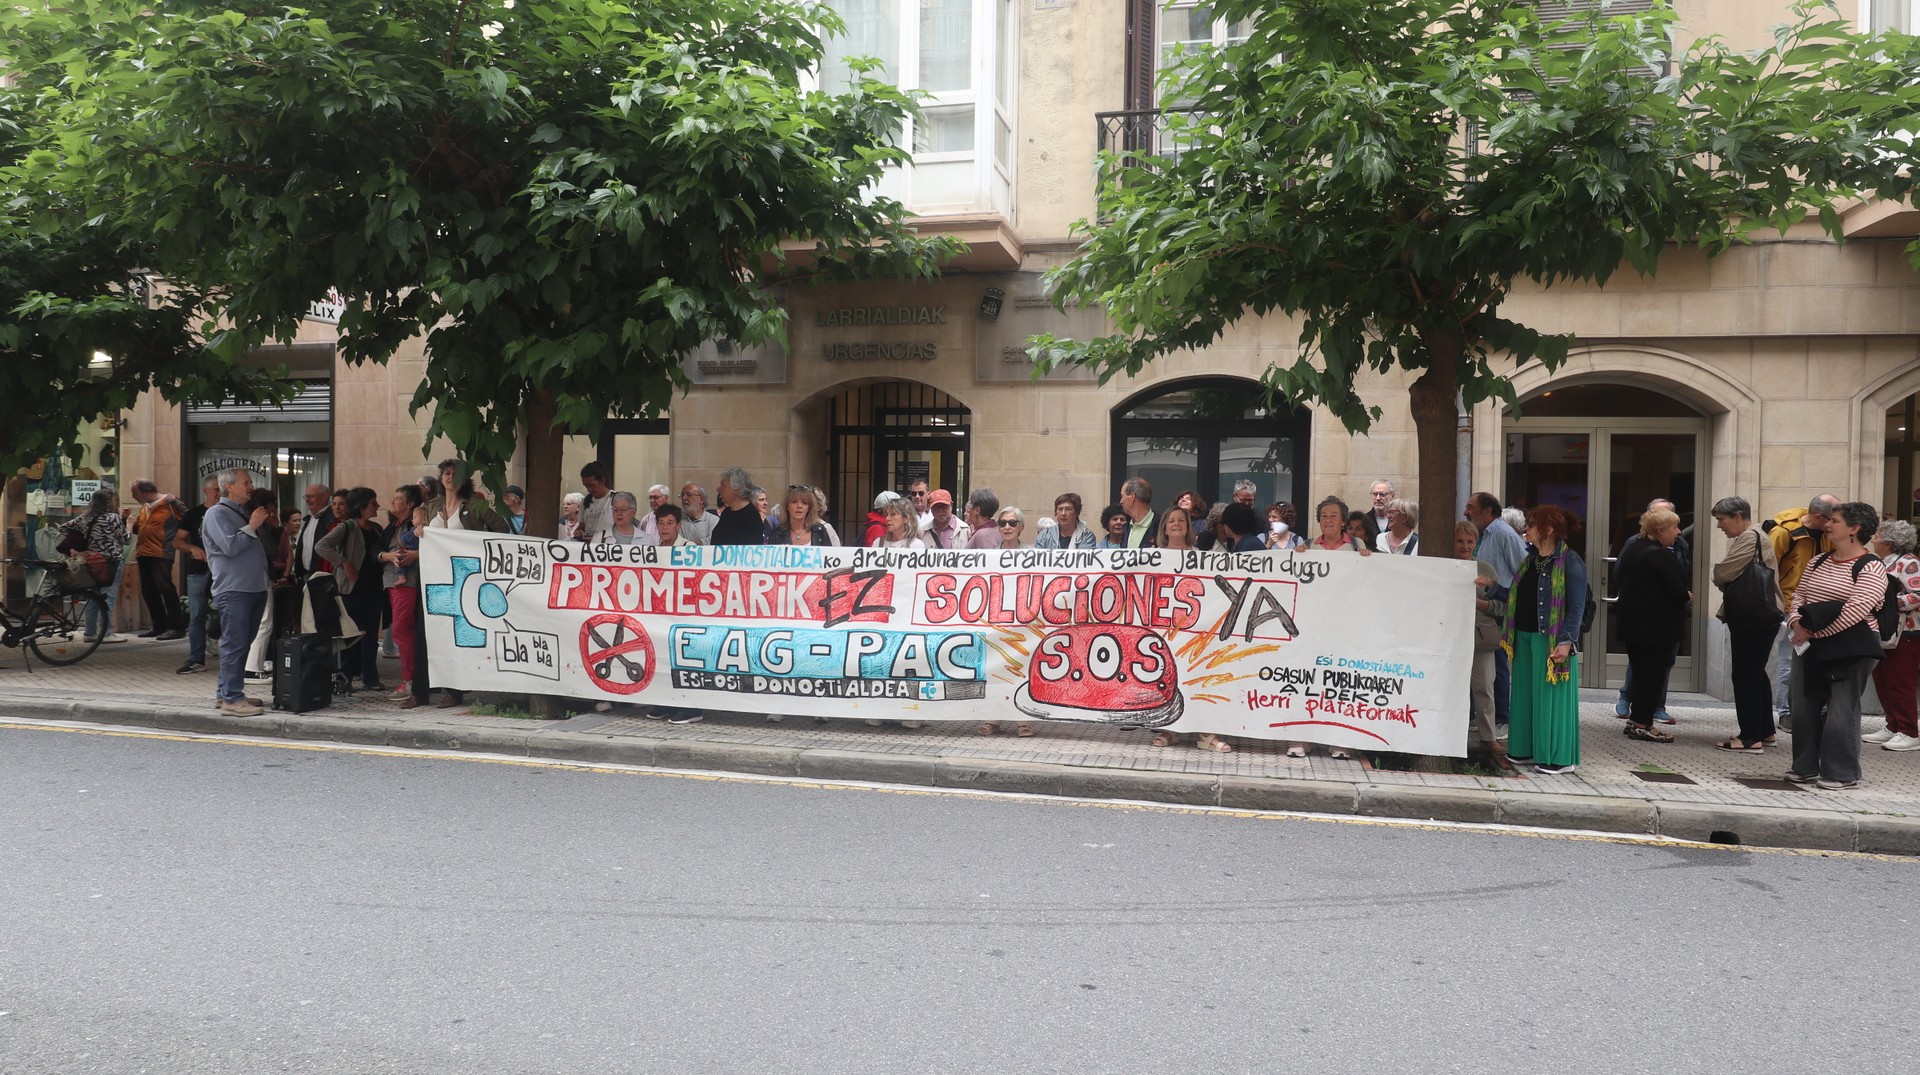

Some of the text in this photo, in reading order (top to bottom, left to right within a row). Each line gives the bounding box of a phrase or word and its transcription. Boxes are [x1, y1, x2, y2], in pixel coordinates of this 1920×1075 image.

[815, 306, 946, 327] LARRIALDIAK
[823, 341, 938, 361] URGENCIAS
[199, 457, 267, 478] PELUQUERIA
[488, 542, 513, 575] bla
[517, 543, 538, 559] bla
[516, 557, 541, 581] bla
[852, 548, 986, 569] arduradunaren
[999, 549, 1104, 569] erantzunik
[1110, 548, 1162, 571] gabe
[1280, 551, 1331, 584] dugu
[819, 566, 896, 628] EZ
[1214, 574, 1299, 643] YA
[503, 635, 529, 663] bla
[532, 636, 549, 651] bla
[674, 626, 977, 680] EAG-PAC
[536, 651, 554, 667] bla
[1038, 632, 1168, 691] S.O.S.
[1258, 666, 1317, 686] OSASUN
[1247, 688, 1293, 711] Herri
[1279, 683, 1389, 707] ALDEKO
